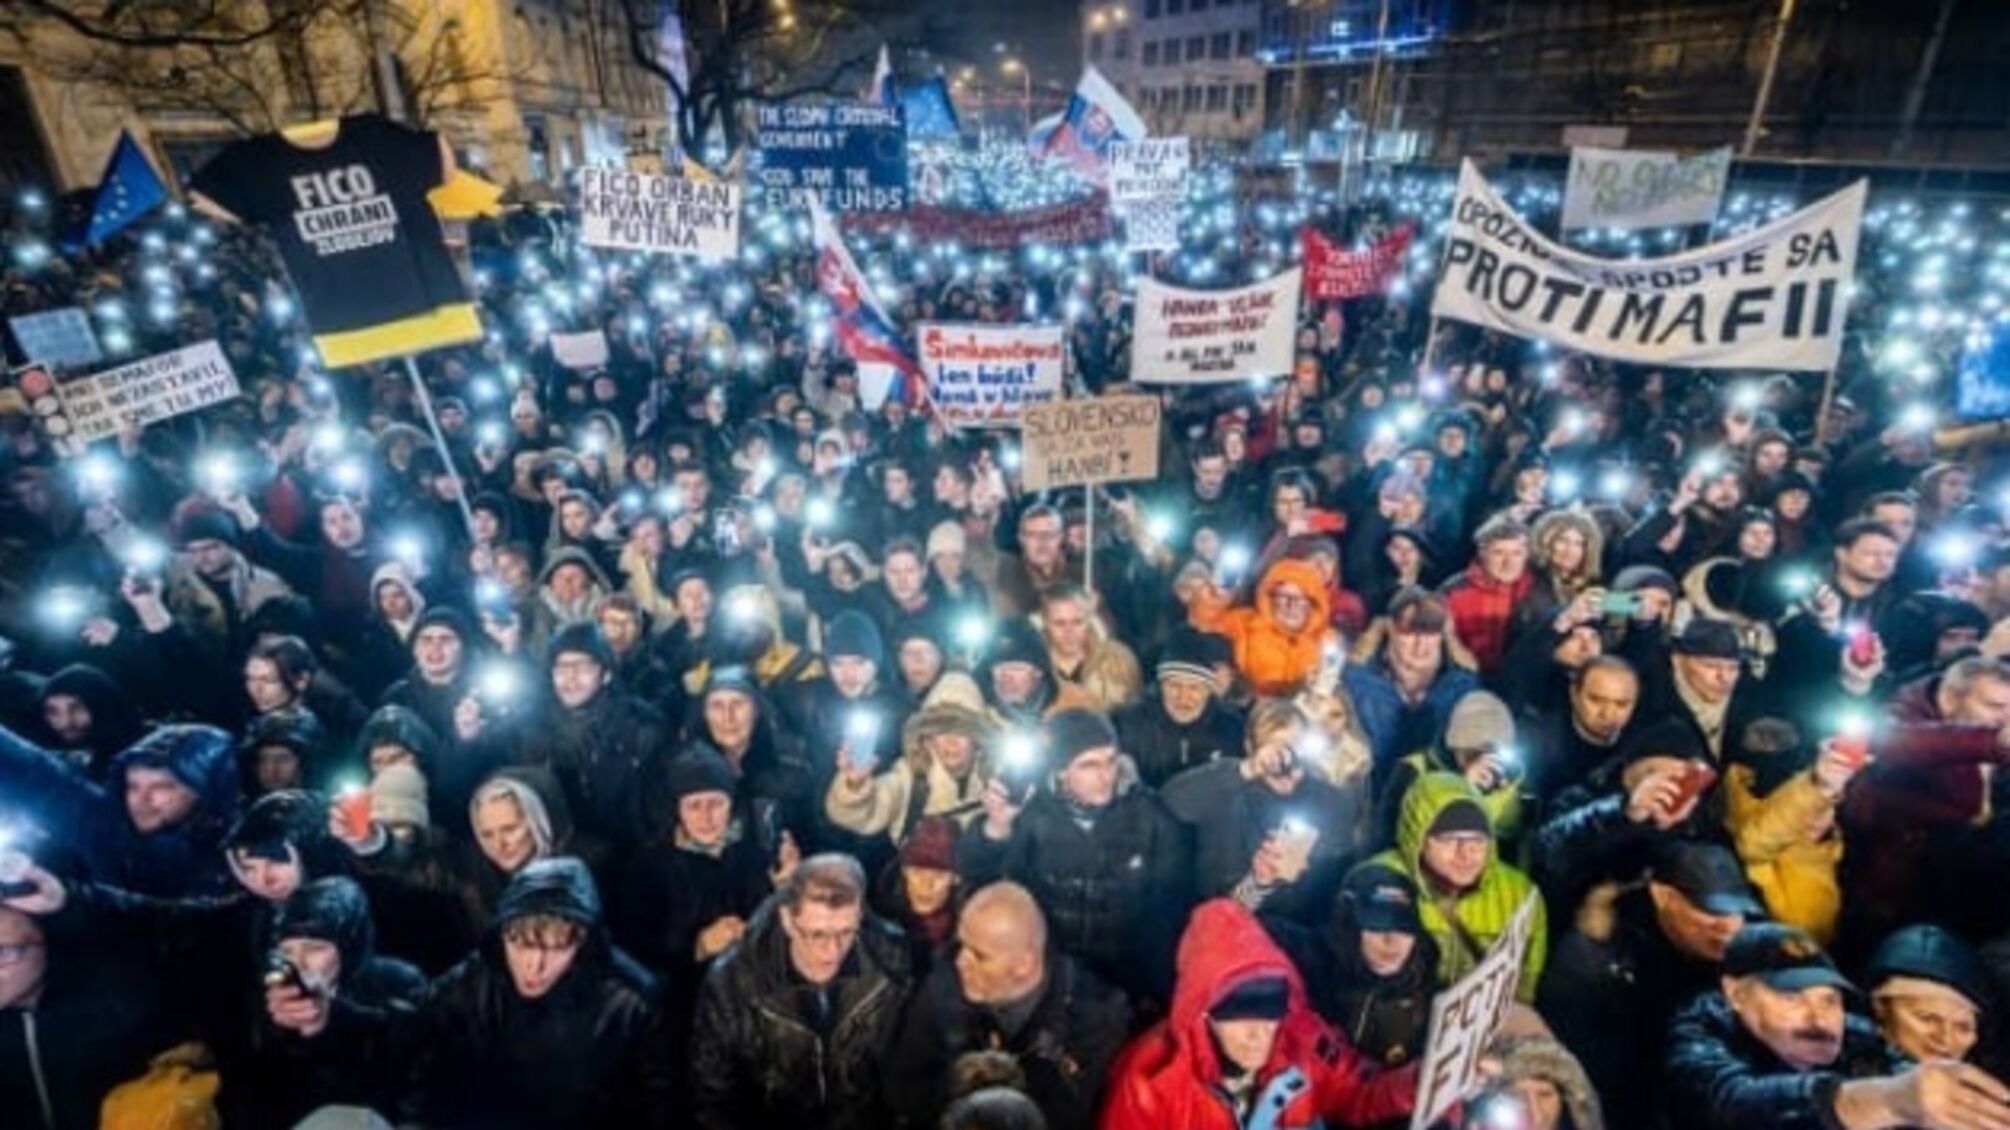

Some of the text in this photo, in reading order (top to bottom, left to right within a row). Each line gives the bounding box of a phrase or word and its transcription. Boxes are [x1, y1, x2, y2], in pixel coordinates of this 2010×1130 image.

[291, 164, 375, 209] FICO
[584, 170, 640, 196] FICO
[609, 218, 699, 248] PUTINA
[677, 203, 733, 230] RUKY
[1786, 229, 1841, 269] SA
[1441, 237, 1604, 333] PROTI
[1609, 278, 1837, 344] MAFII
